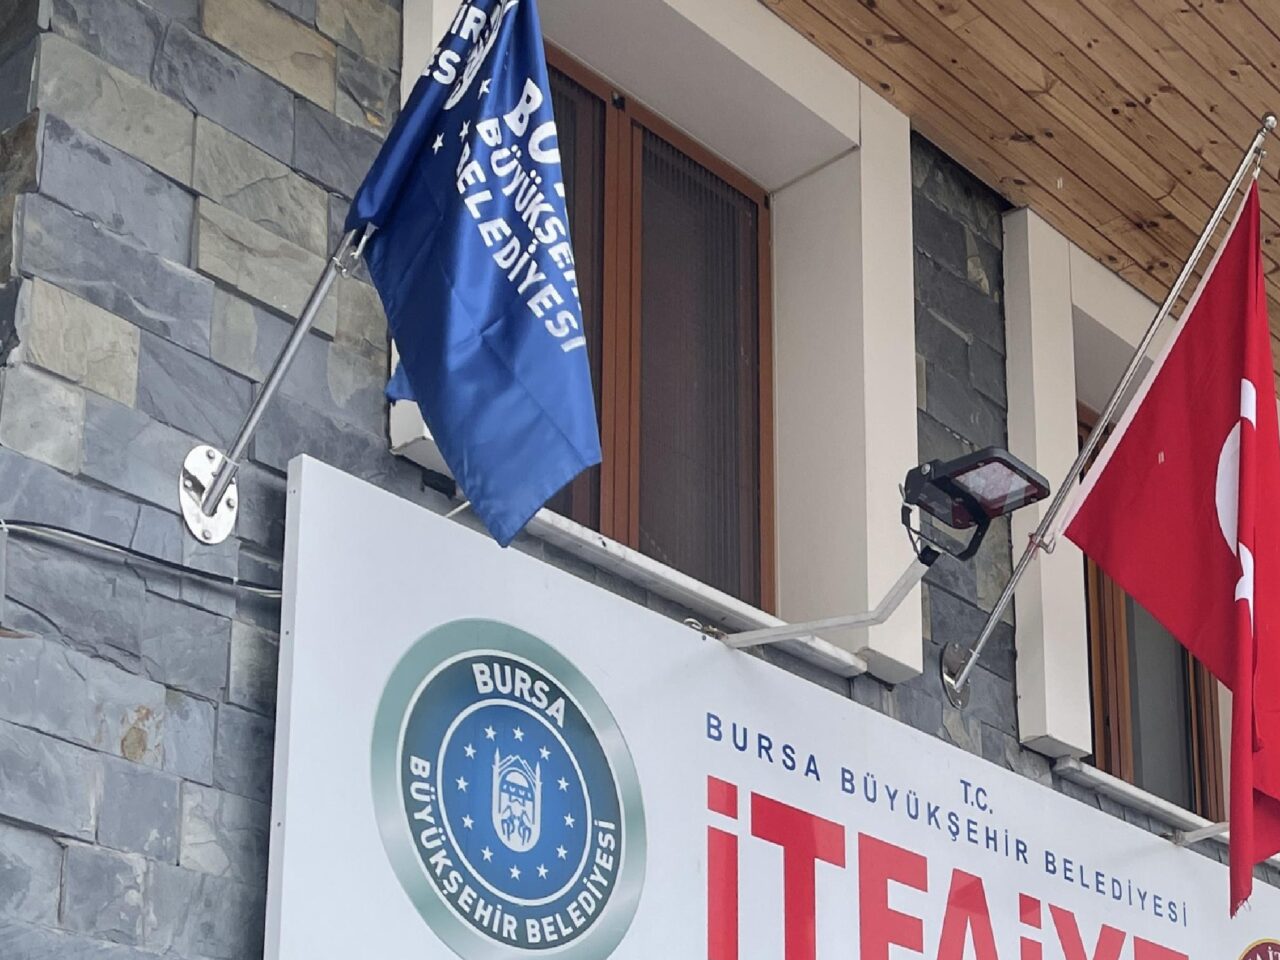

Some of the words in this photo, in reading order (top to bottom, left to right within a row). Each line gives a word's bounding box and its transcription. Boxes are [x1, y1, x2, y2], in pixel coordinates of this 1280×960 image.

[471, 662, 566, 729] BURSA
[408, 754, 518, 941] BÜYÜKŞEHİR
[525, 818, 617, 944] BELEDİYESİ
[706, 711, 822, 783] BURSA
[840, 766, 1030, 865] BÜYÜKŞEHİR
[1044, 850, 1189, 928] BELEDİYESİ
[959, 778, 994, 815] T.C.
